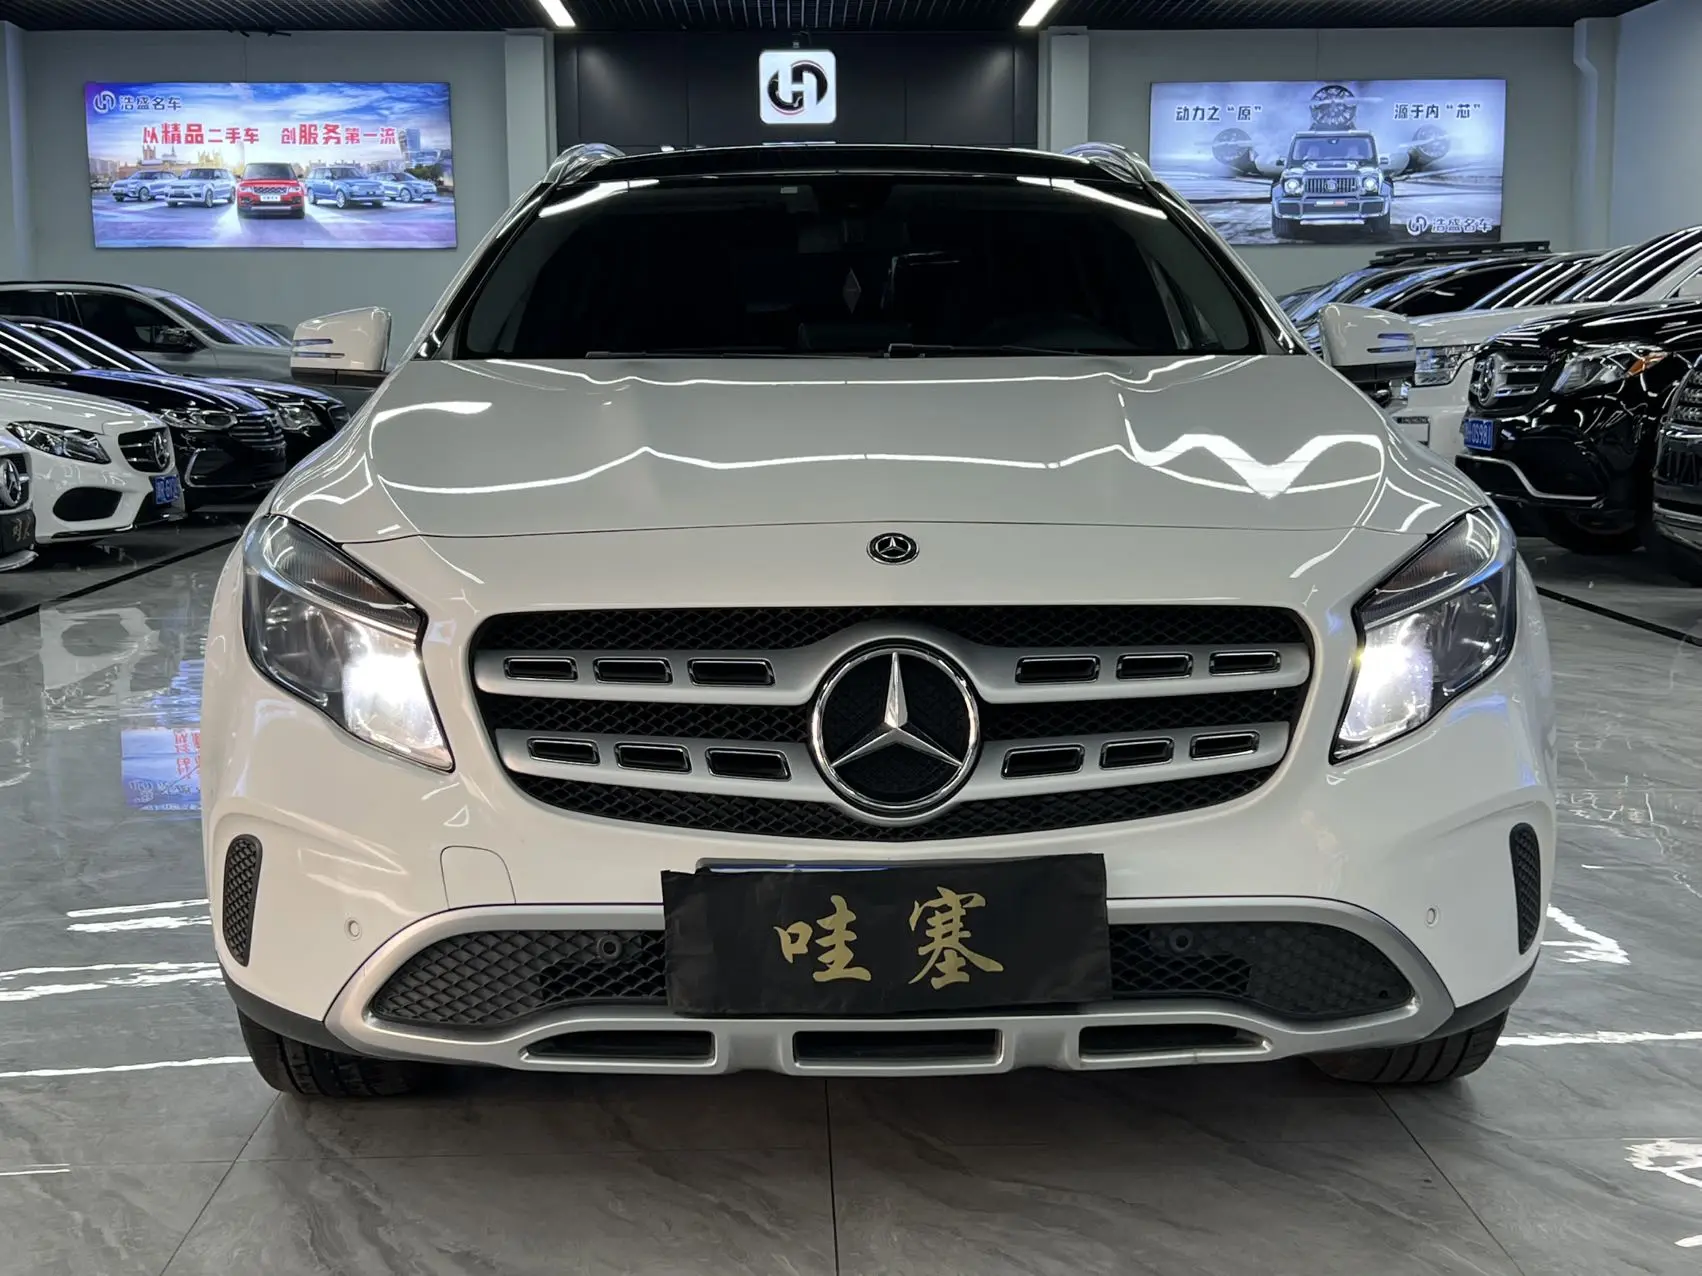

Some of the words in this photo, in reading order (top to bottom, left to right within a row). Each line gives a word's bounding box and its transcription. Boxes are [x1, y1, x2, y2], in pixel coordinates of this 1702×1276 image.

[120, 95, 182, 111] 浩盛名车
[143, 122, 260, 145] 以精品二手车
[281, 123, 396, 145] 创服务第一流
[1432, 217, 1492, 233] 浩盛名车
[773, 885, 1004, 990] 哇塞
